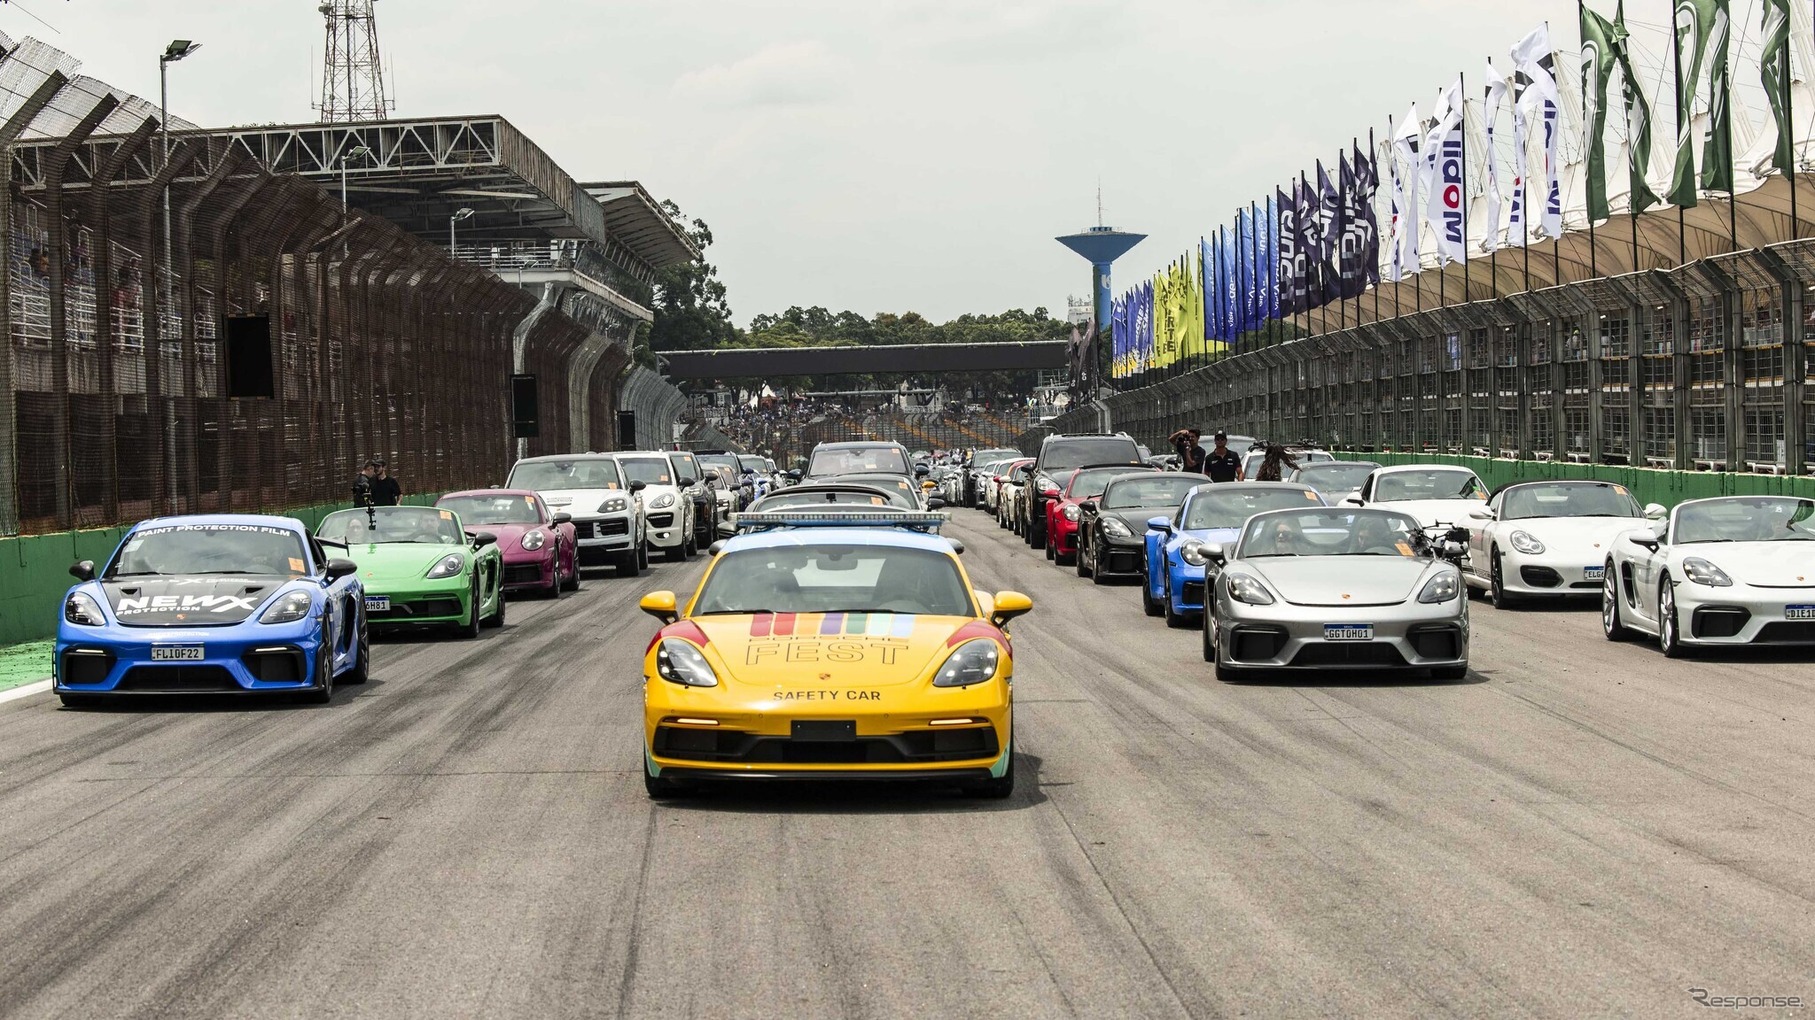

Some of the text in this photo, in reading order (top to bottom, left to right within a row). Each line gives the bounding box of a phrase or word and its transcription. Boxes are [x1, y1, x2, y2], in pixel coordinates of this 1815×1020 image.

[137, 525, 291, 538] PAINT PROTECTION FILM
[116, 605, 200, 616] PROTECTION
[117, 595, 258, 613] NEWX
[745, 642, 909, 666] FEST
[773, 690, 881, 701] SAFETY CAR
